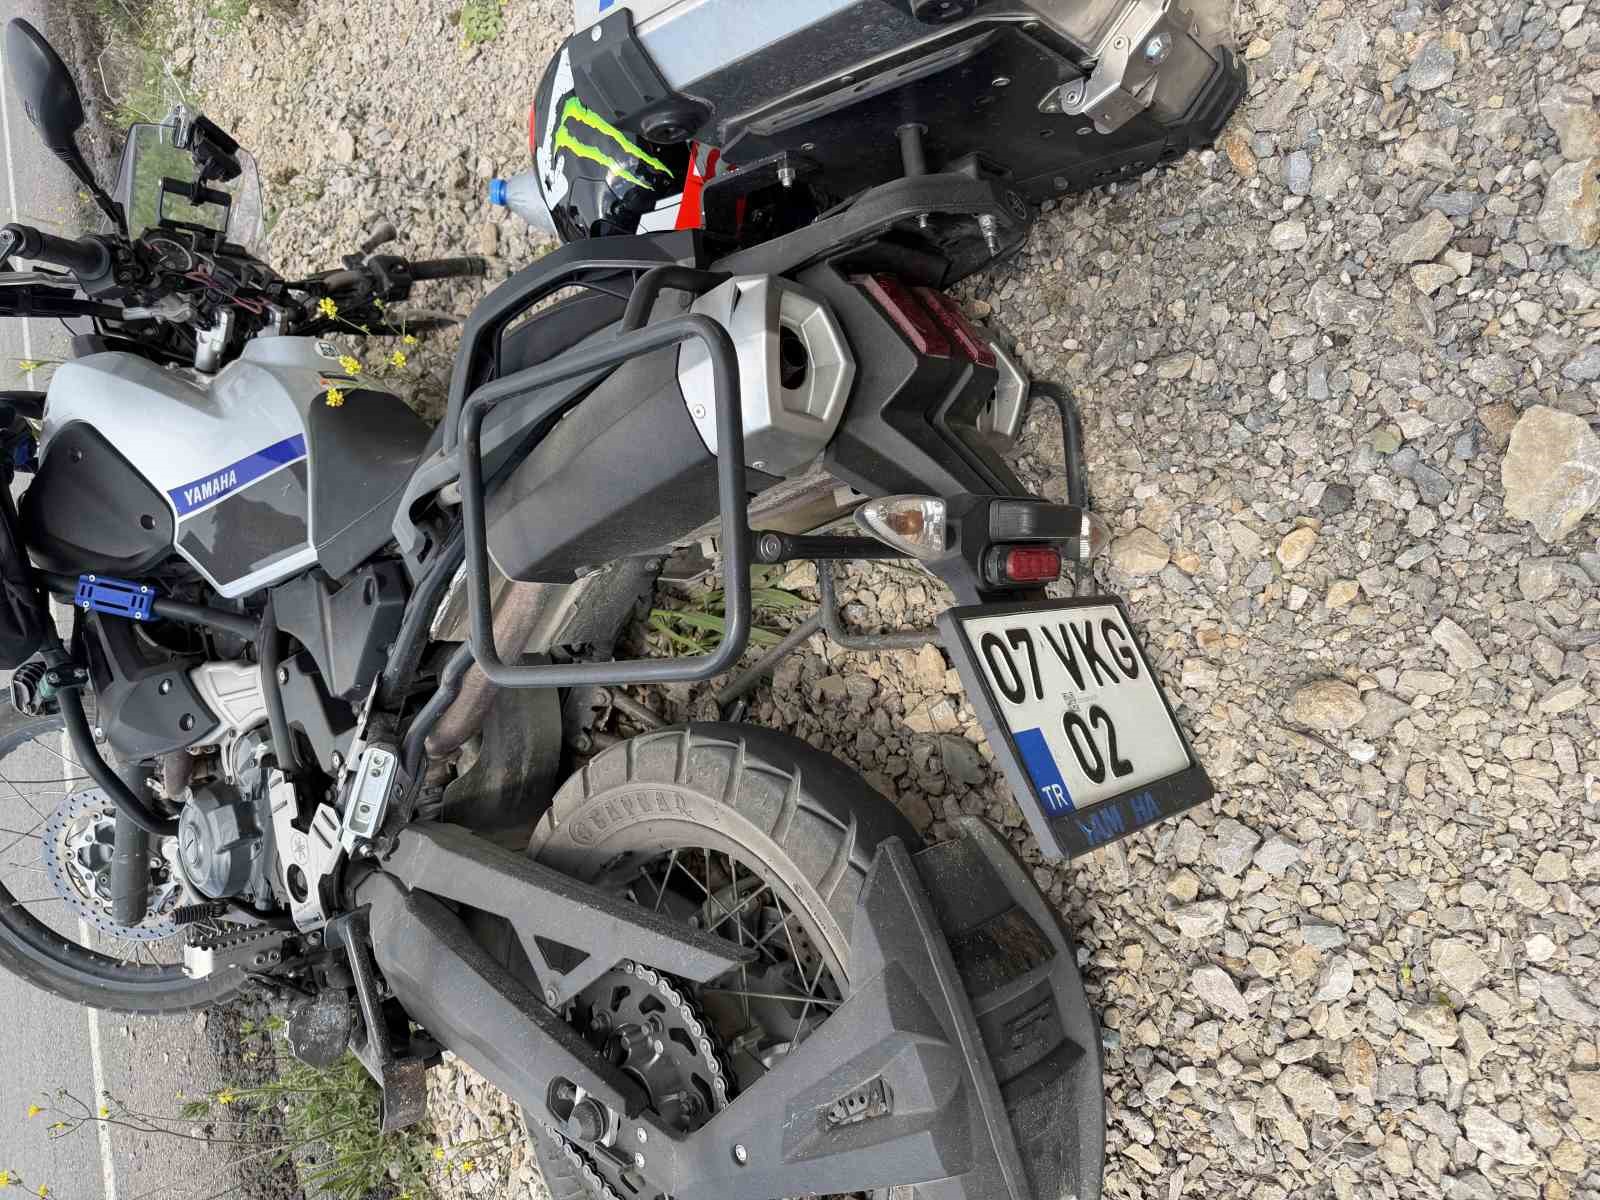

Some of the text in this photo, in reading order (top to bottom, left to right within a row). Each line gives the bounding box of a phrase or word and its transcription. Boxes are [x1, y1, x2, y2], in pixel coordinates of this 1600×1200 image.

[183, 469, 237, 506] YAMAHA
[980, 618, 1139, 704] 07 VKG
[1062, 705, 1134, 784] 02
[1041, 783, 1069, 811] TR
